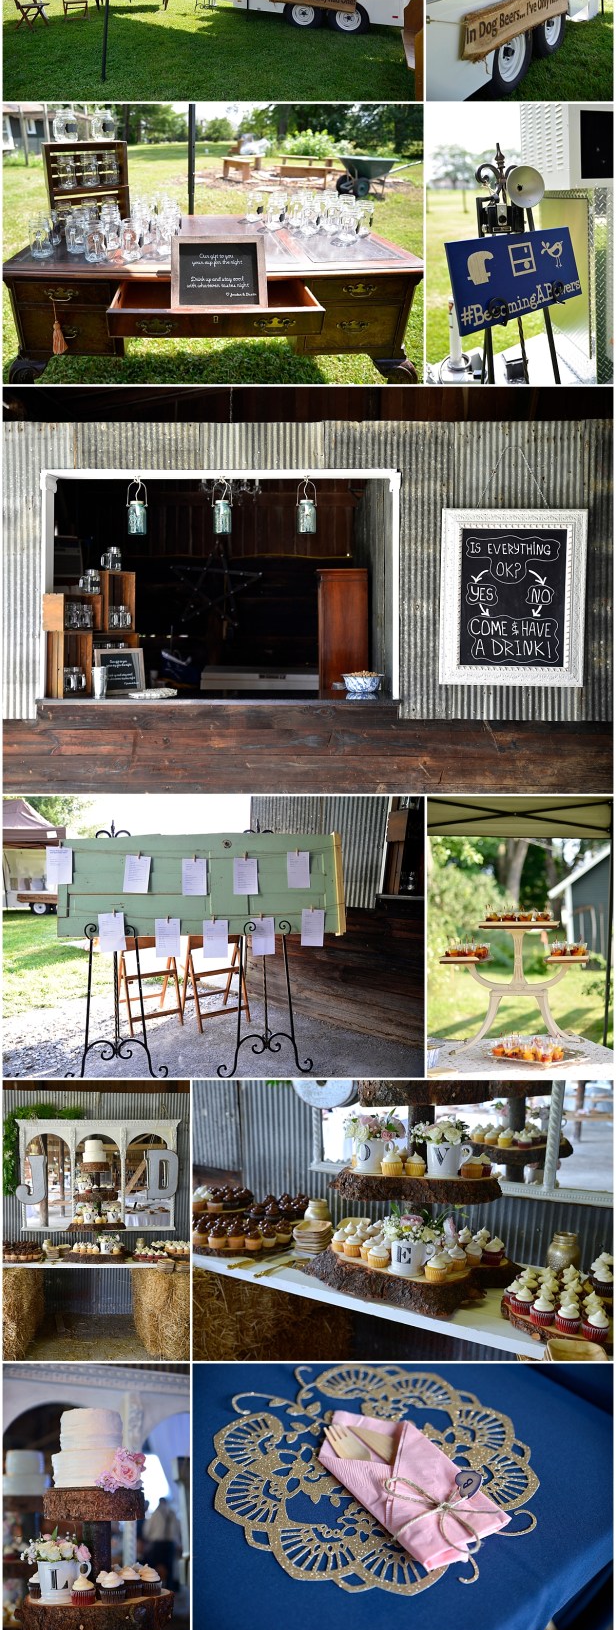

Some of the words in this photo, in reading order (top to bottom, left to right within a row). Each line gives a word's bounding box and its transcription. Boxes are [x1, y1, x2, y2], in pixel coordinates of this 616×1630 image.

[466, 28, 476, 44] In
[479, 18, 498, 37] Dog
[526, 2, 537, 15] I've
[470, 542, 481, 554] IS
[487, 542, 551, 556] EVERYTHING
[496, 562, 522, 578] OK?
[469, 586, 494, 602] YES
[531, 588, 551, 603] NO
[470, 618, 508, 636] COME
[522, 621, 551, 637] HAVE
[475, 638, 485, 656] A
[491, 638, 551, 658] DRINK!
[16, 1155, 48, 1205] J
[144, 1149, 178, 1200] D
[397, 1245, 411, 1264] E
